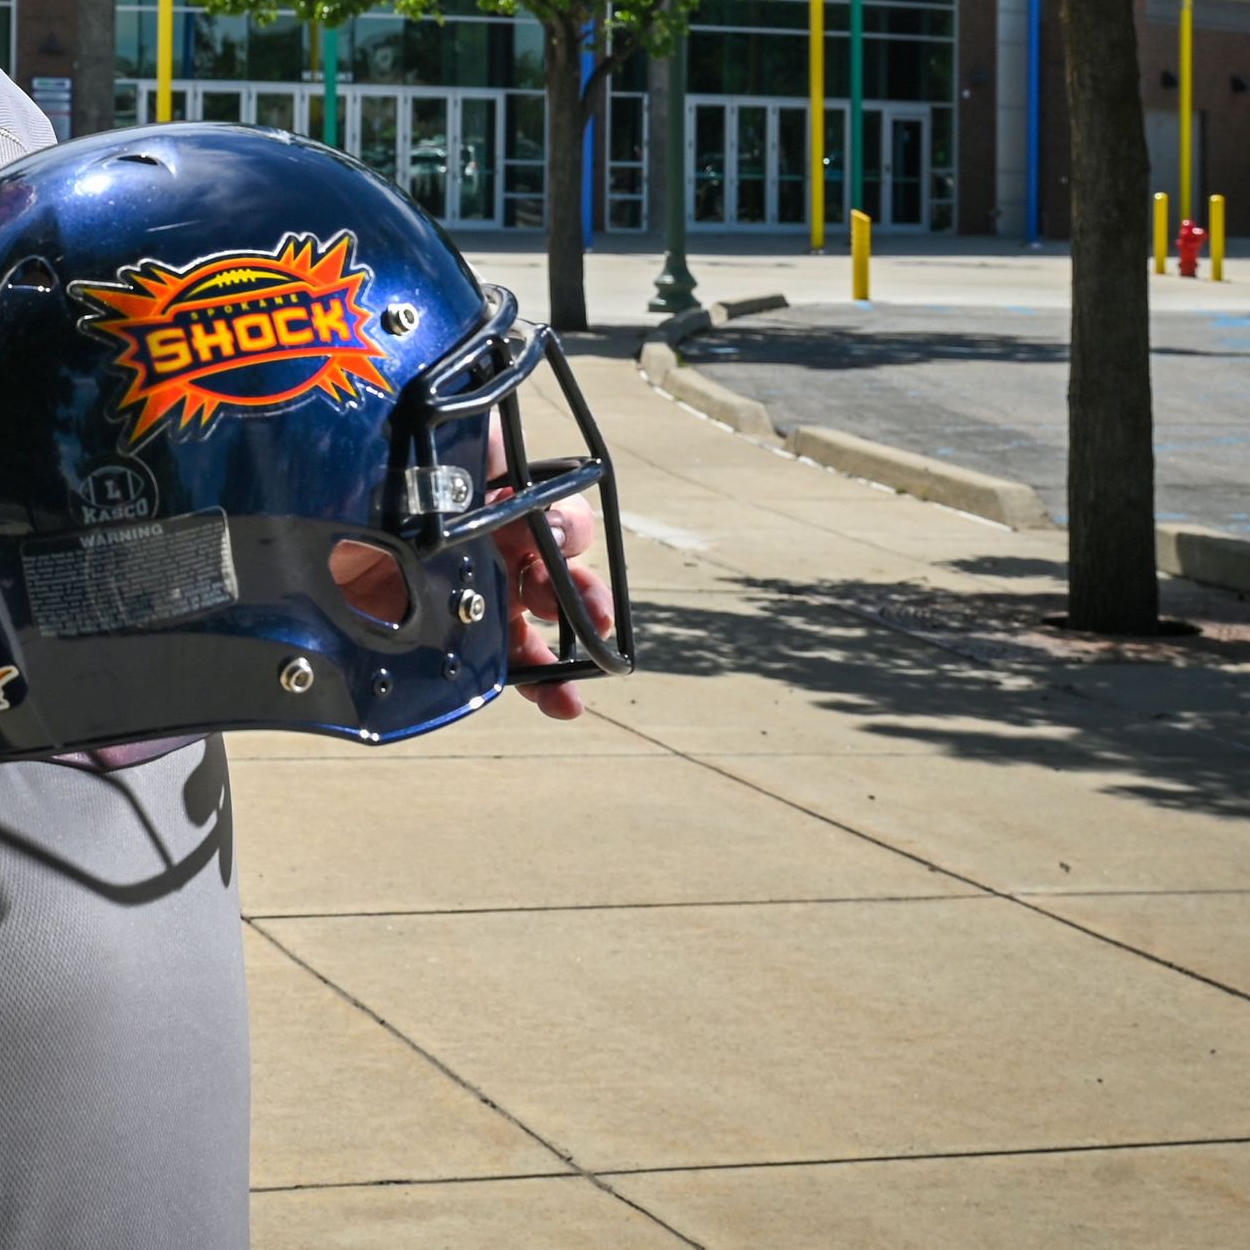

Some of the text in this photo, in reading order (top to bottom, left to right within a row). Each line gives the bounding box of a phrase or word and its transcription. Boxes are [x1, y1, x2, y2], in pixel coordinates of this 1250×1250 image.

[191, 294, 301, 322] SPOKANE
[145, 297, 352, 375] SHOCK
[79, 523, 164, 549] WARNING
